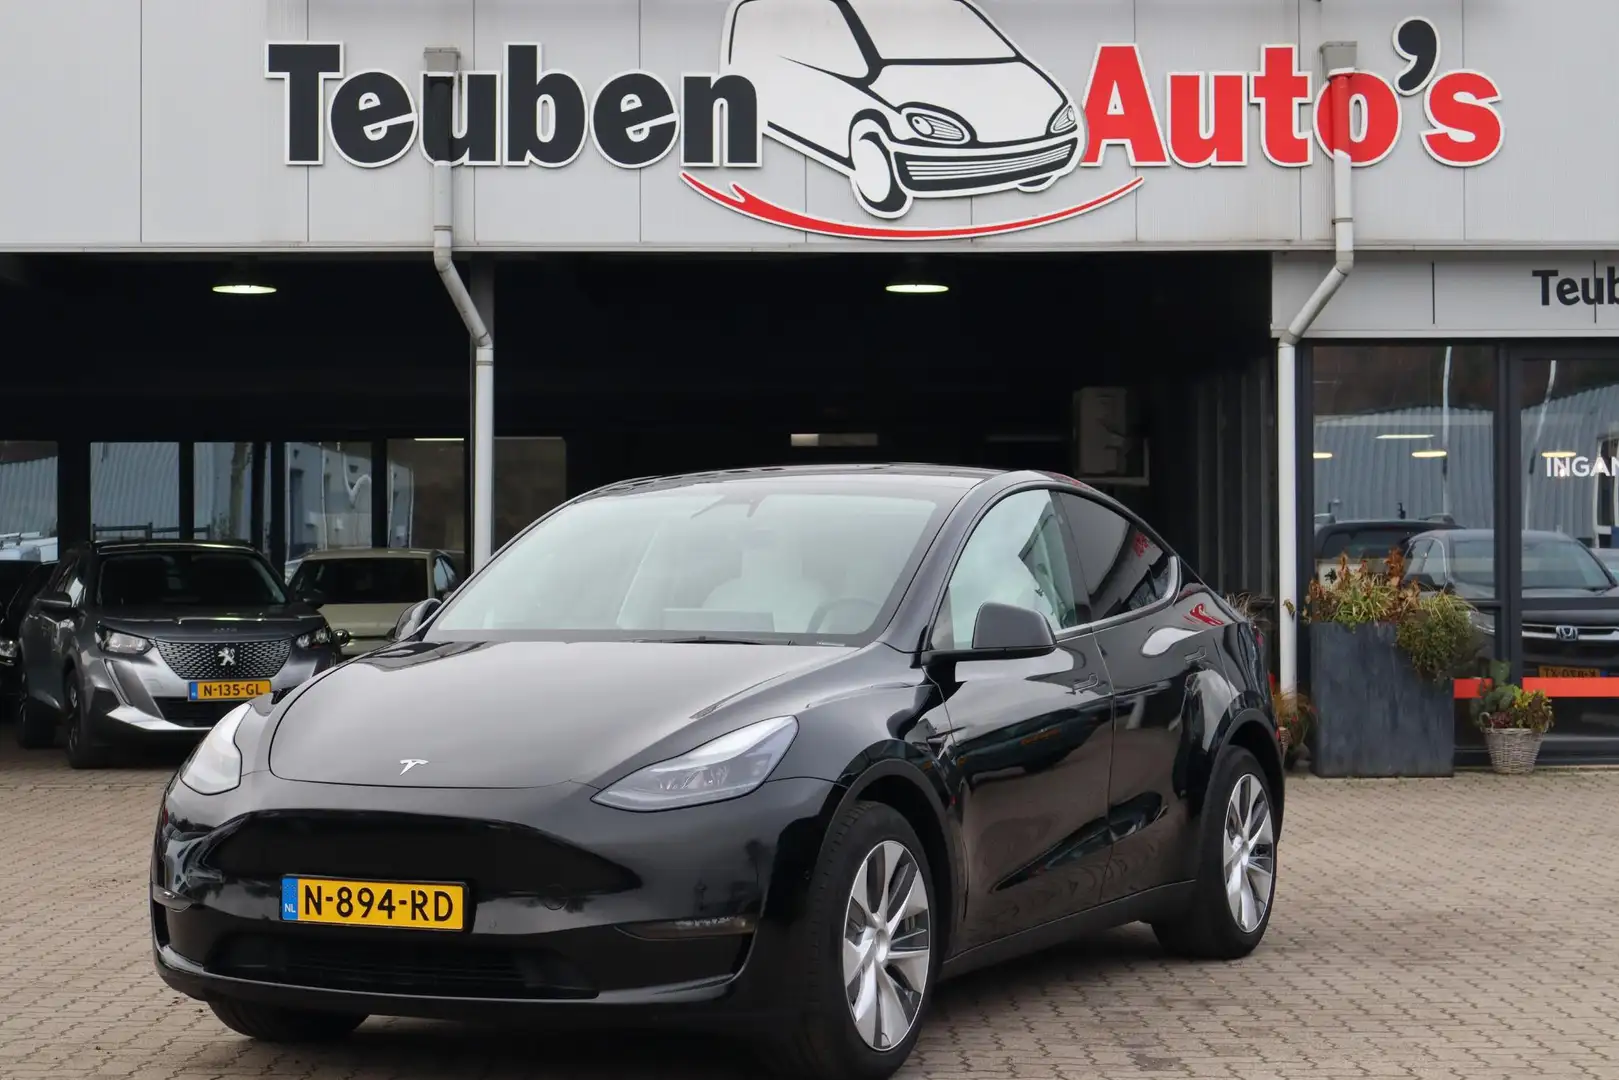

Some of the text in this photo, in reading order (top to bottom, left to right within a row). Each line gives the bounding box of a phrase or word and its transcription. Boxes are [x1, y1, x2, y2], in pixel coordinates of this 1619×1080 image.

[265, 16, 1505, 168] Teuben Auto's
[203, 684, 263, 697] N-135-GL
[284, 885, 454, 922] NL N-894-RD
